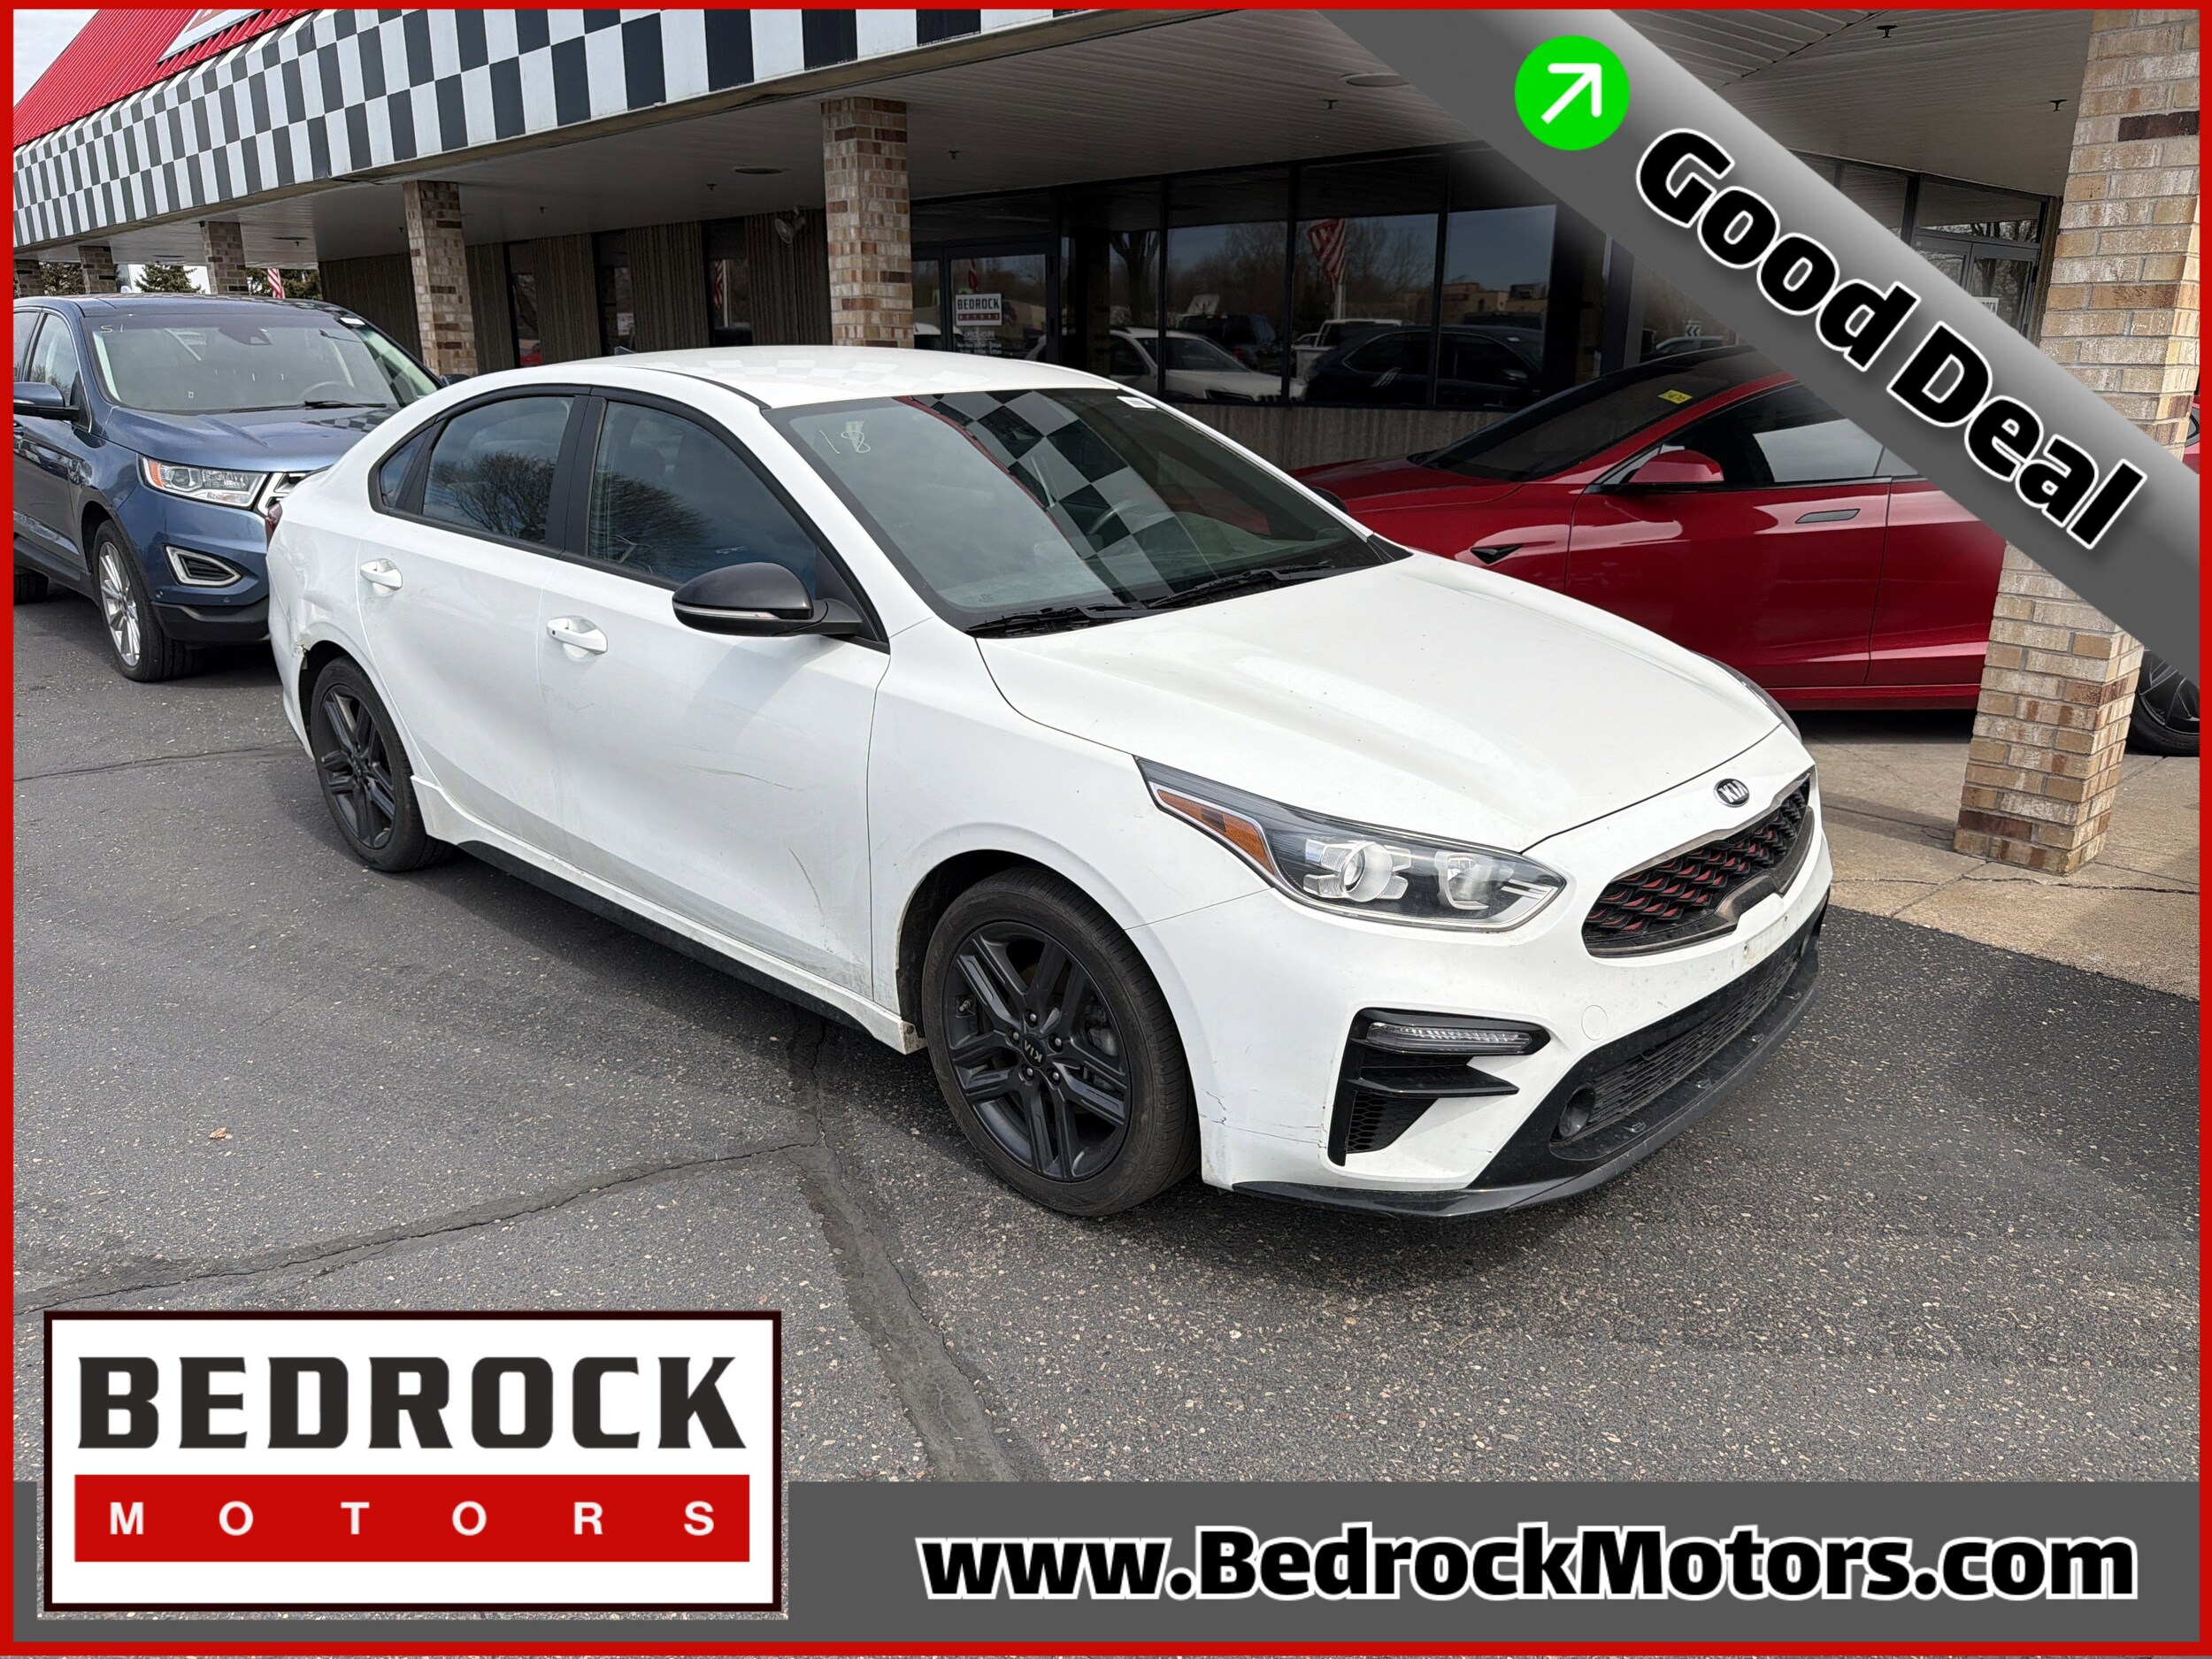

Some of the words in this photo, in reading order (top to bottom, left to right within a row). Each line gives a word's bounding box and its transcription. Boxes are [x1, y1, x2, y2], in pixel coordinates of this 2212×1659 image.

[957, 297, 1000, 310] BEDROCK
[1717, 780, 1750, 804] KIA
[1023, 1039, 1043, 1064] KIA
